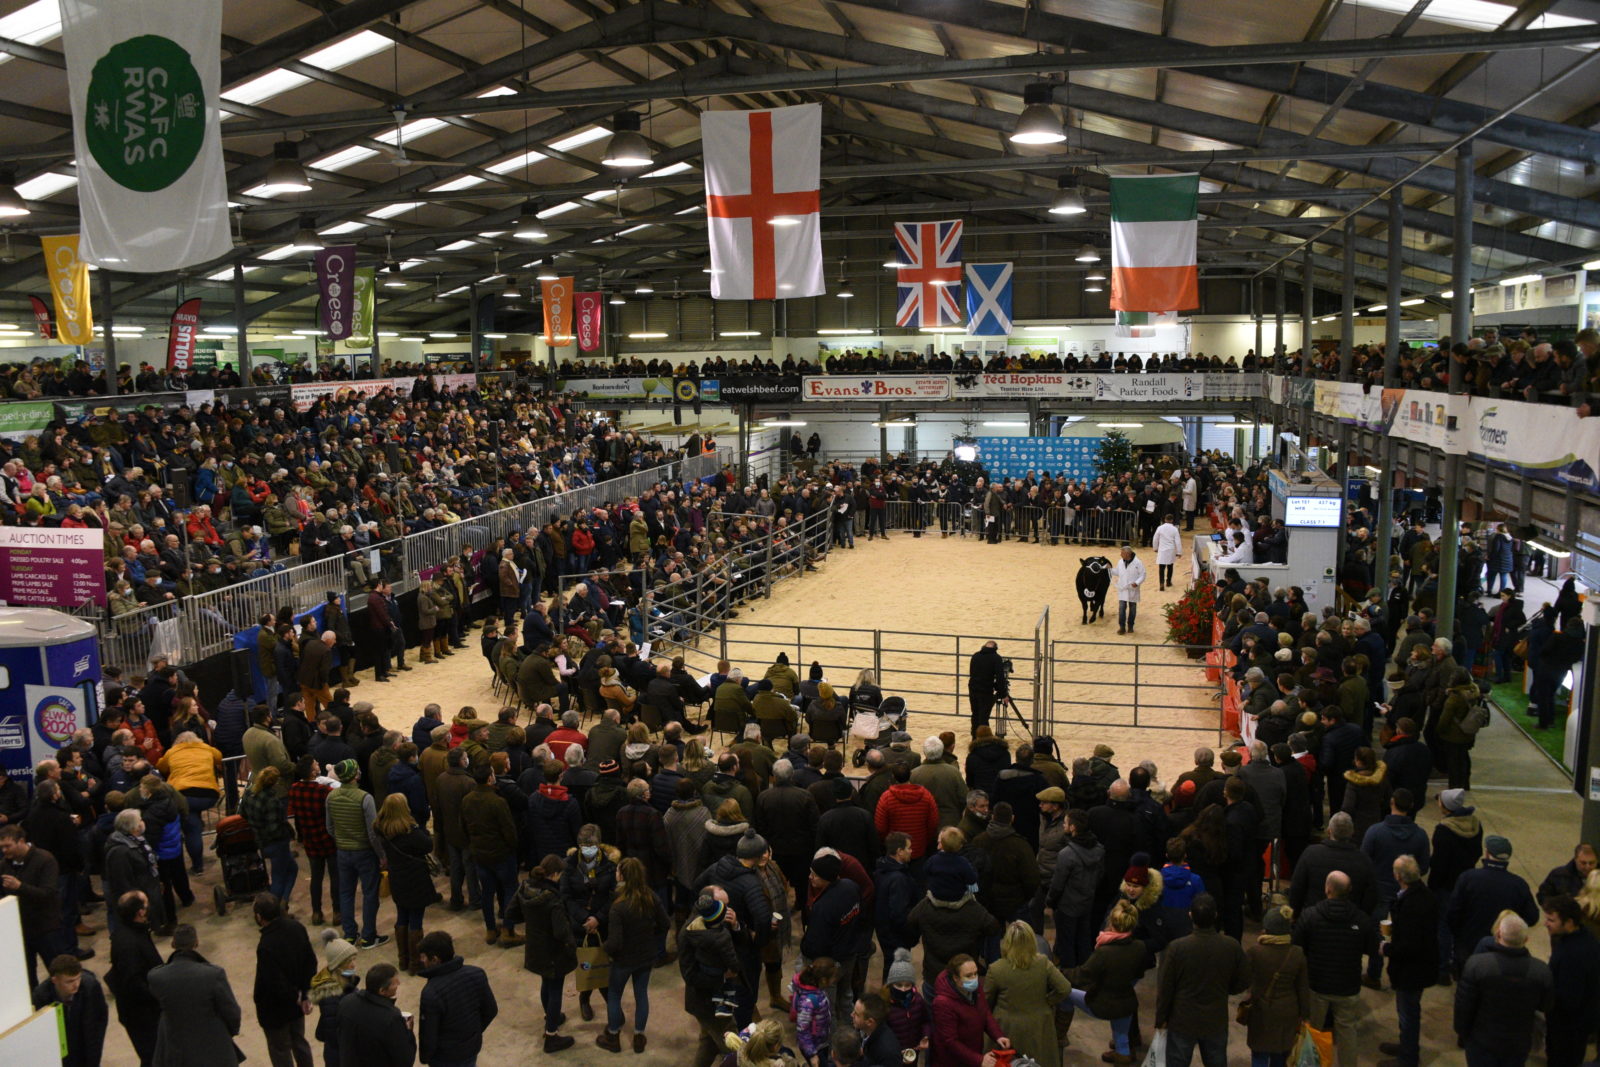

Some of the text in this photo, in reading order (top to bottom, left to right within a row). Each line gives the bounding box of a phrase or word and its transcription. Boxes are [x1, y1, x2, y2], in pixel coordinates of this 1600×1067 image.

[123, 67, 146, 165] RWAS
[147, 67, 169, 159] CAFC
[326, 254, 344, 335] Croeso
[176, 313, 197, 322] MAYO
[550, 283, 565, 342] Croeso
[582, 297, 594, 347] Croeso
[174, 325, 192, 369] BOLUS
[810, 380, 917, 396] Evans Bros.
[983, 374, 1062, 386] Ted Hopkins
[1132, 378, 1166, 386] Randall
[722, 384, 799, 394] eatwelshbeef.com
[1120, 388, 1178, 396] Parker Foods
[9, 534, 85, 545] AUCTION TIMES
[41, 710, 77, 722] CLWYD
[41, 719, 77, 736] 2020
